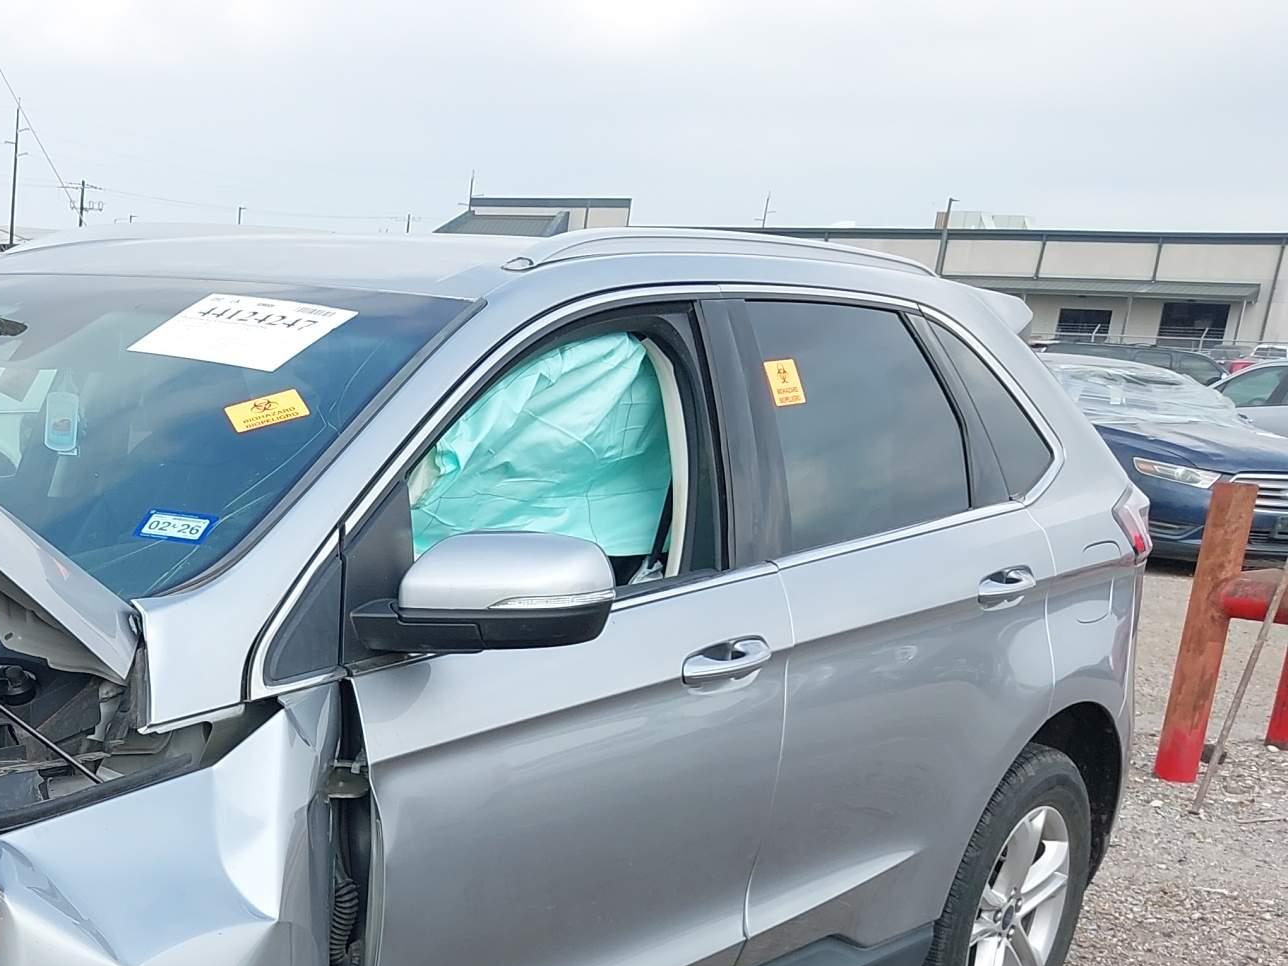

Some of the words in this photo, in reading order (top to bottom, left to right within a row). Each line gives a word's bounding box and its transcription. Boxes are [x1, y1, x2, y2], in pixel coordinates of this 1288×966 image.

[198, 306, 319, 331] 44124247
[243, 406, 296, 424] BIOHAZARD
[148, 520, 172, 532] 02
[177, 523, 202, 535] 26
